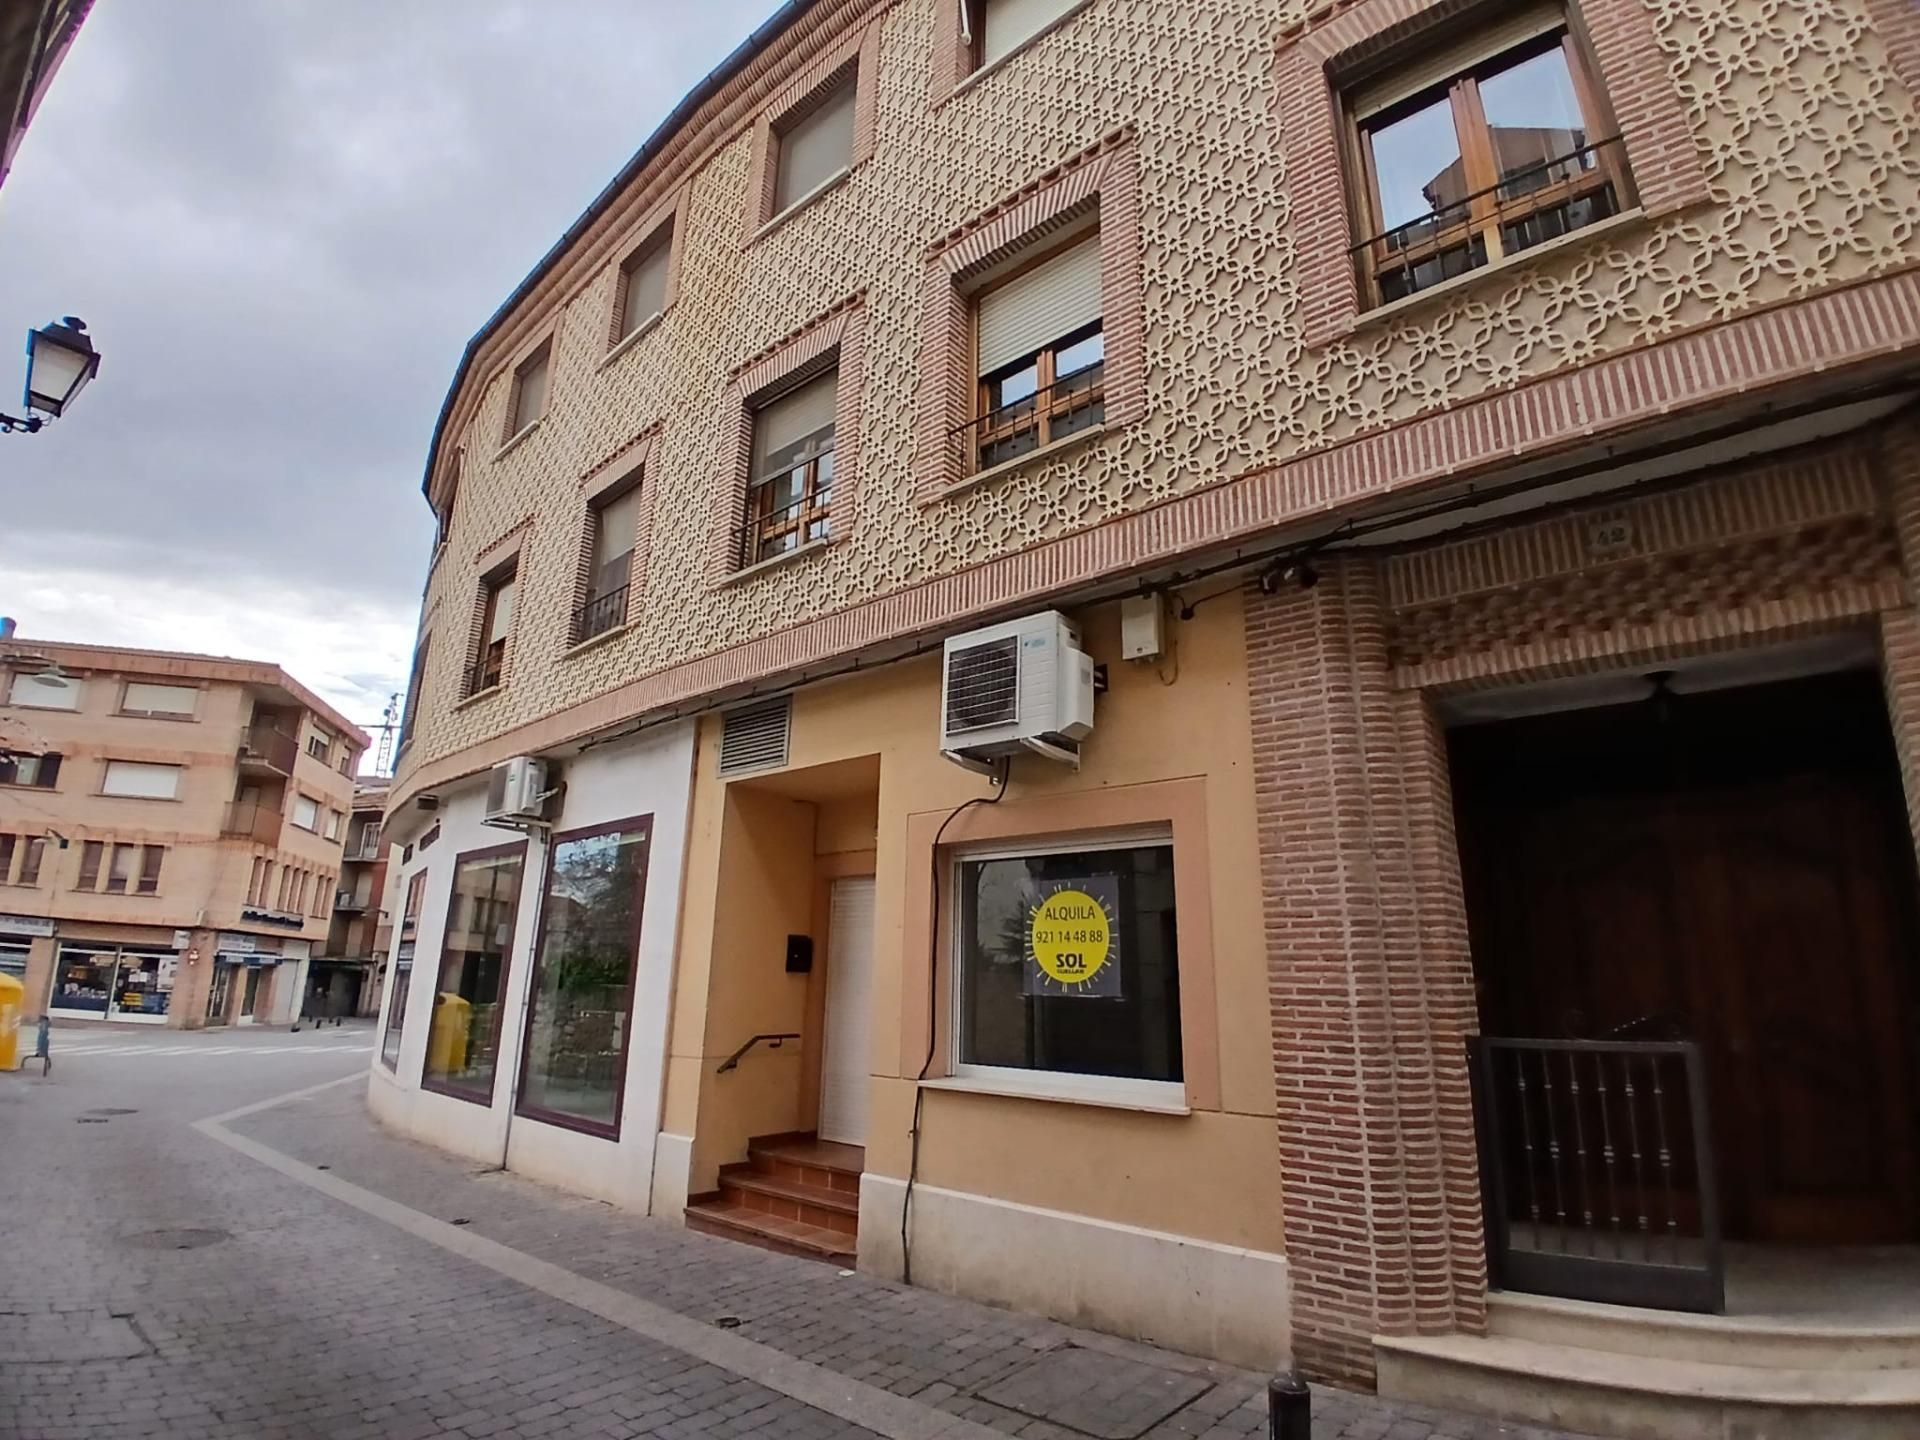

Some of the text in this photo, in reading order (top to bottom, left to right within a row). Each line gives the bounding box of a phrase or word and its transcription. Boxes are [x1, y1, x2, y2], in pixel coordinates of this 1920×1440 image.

[1045, 905, 1096, 921] ALQUILA
[1036, 930, 1103, 943] 921 14 48 88
[1056, 953, 1087, 968] SOL
